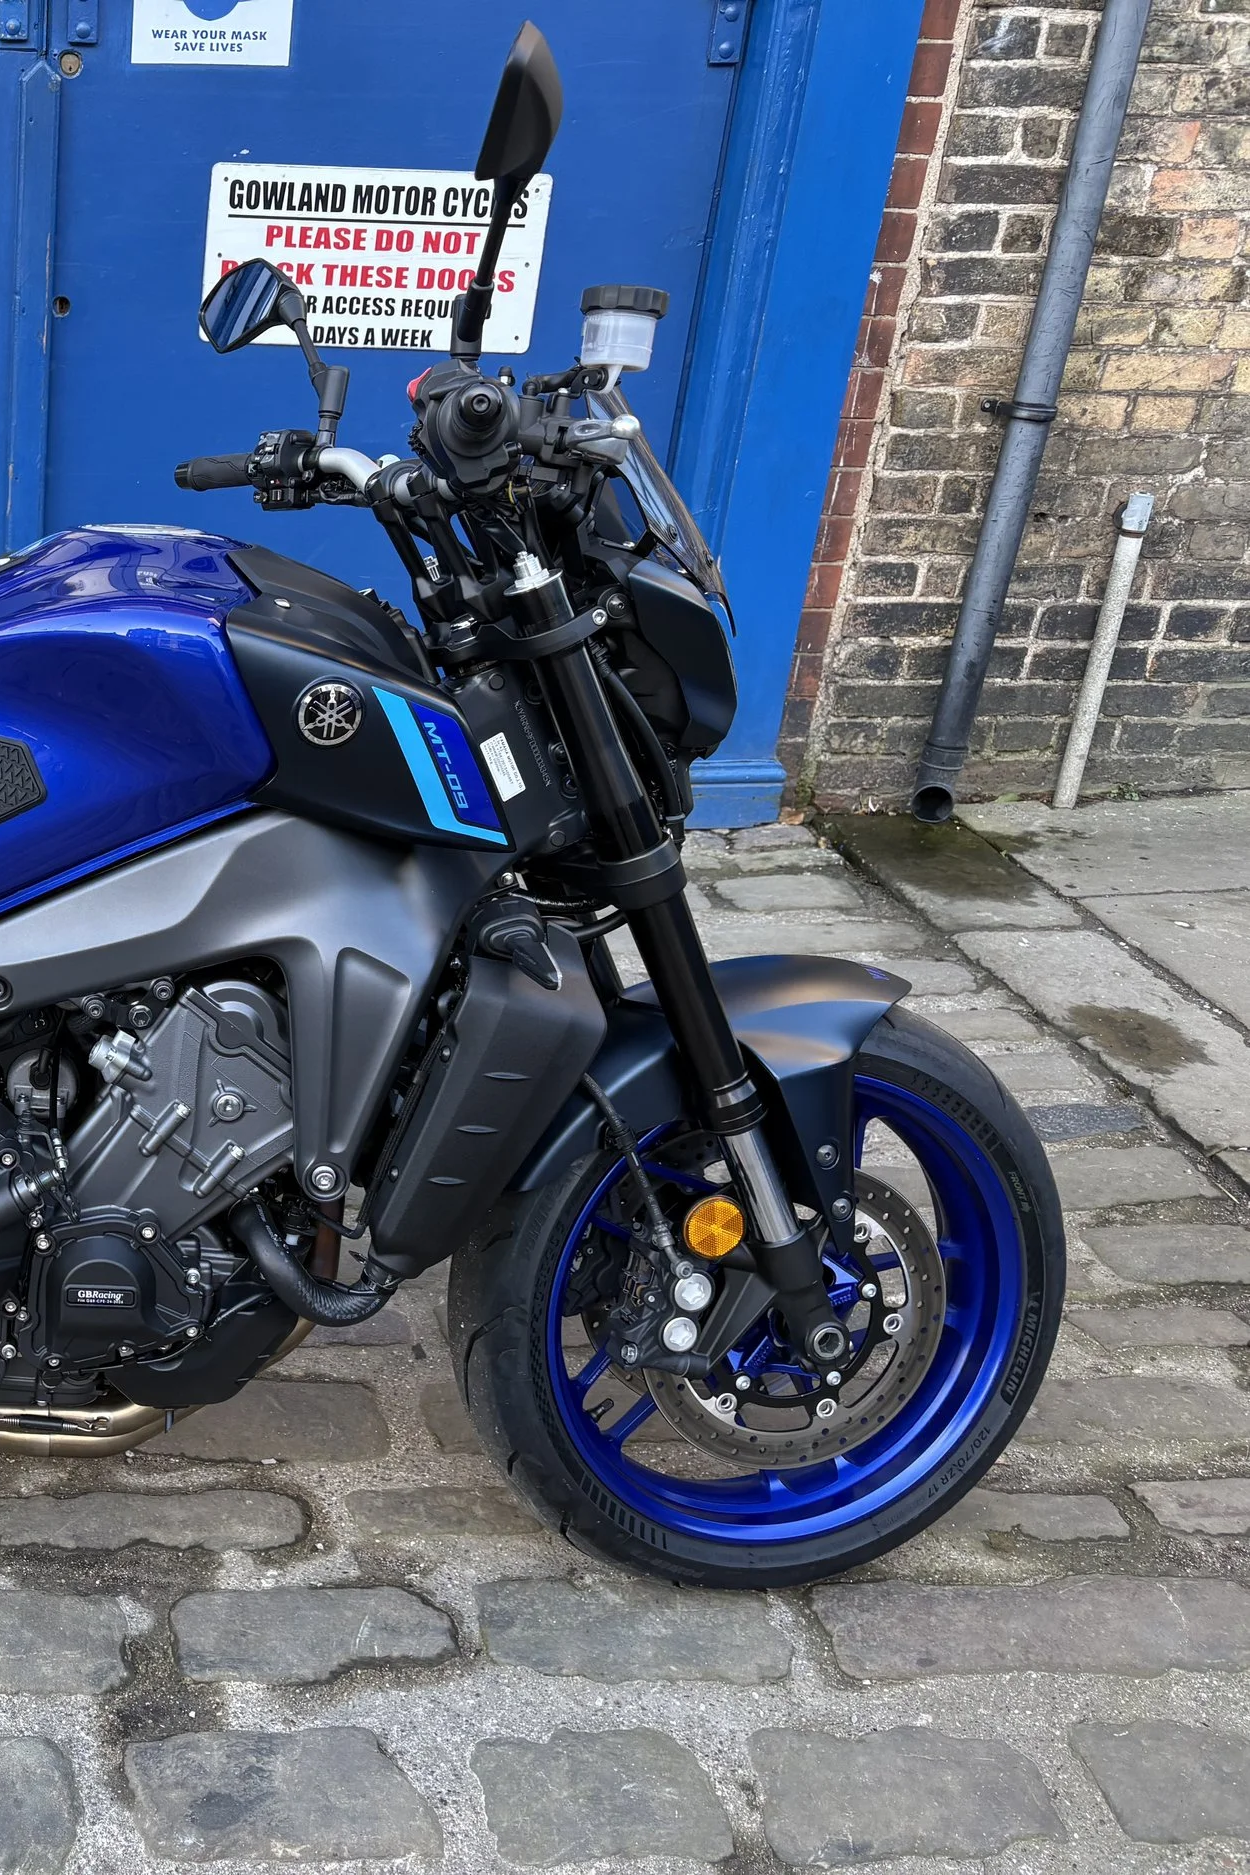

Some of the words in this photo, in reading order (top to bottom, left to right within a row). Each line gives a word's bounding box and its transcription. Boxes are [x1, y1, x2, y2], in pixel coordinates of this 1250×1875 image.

[151, 29, 188, 39] WEAR
[192, 29, 226, 40] YOUR
[231, 30, 267, 41] MASK
[174, 41, 205, 52] SAVE
[209, 42, 243, 52] LIVES
[228, 179, 347, 213] GOWLAND
[352, 184, 437, 216] MOTOR
[442, 186, 529, 219] CYCS
[265, 224, 368, 251] PLEASE
[374, 229, 414, 252] DO
[422, 231, 481, 254] NOT
[322, 264, 410, 289] THESE
[416, 267, 516, 293] DOOS
[322, 295, 396, 317] ACCESS
[313, 326, 359, 345] DAYS
[363, 326, 375, 346] A
[381, 327, 434, 348] WEEK
[423, 722, 469, 808] MT-09
[1008, 1170, 1025, 1202] FRONT
[77, 1289, 123, 1300] GBRacing
[1005, 1311, 1041, 1396] MICHELIN
[957, 1426, 990, 1468] 120/70
[940, 1467, 956, 1485] ZR
[928, 1483, 940, 1498] 17
